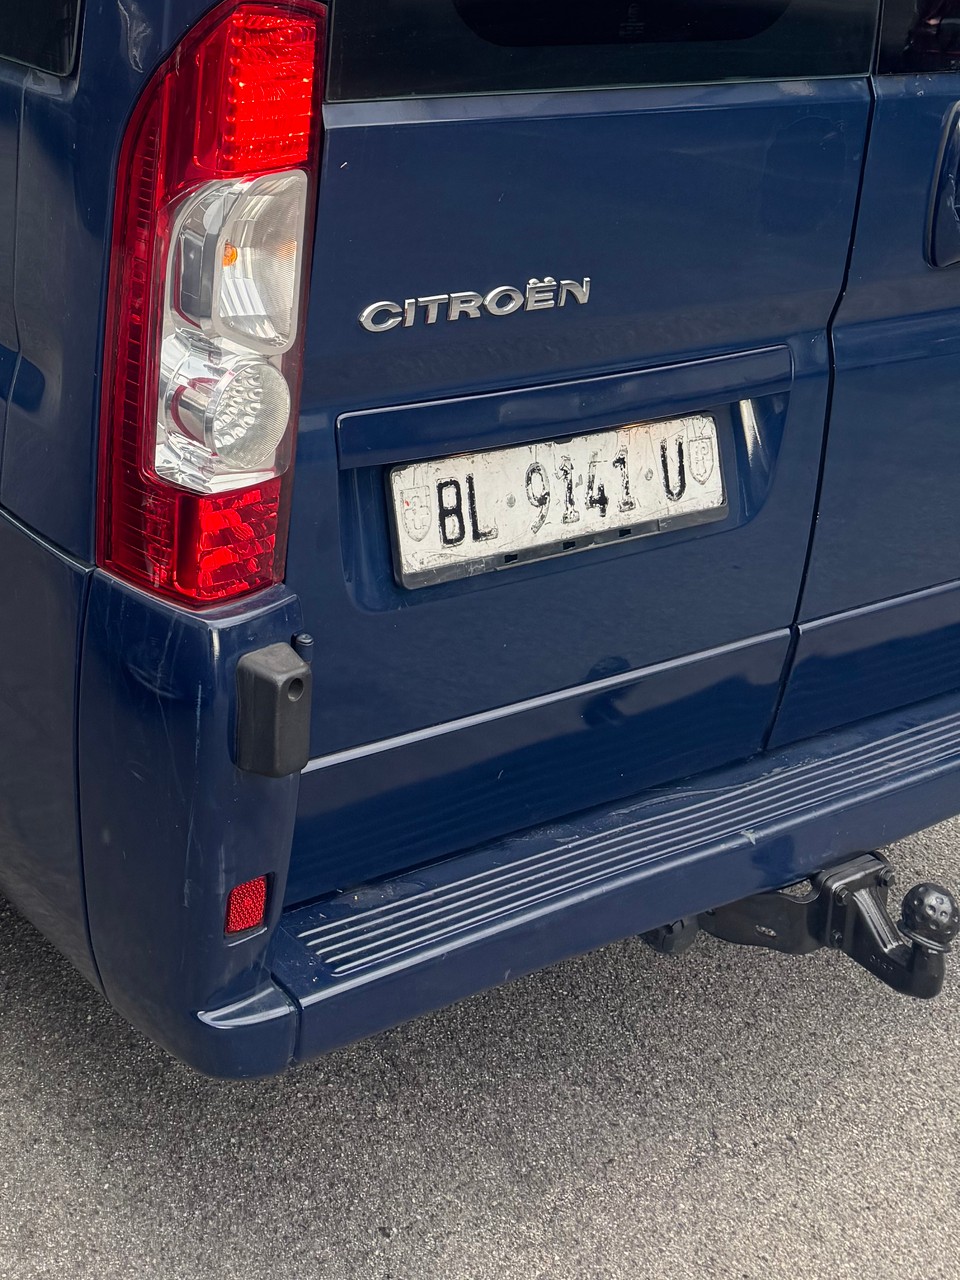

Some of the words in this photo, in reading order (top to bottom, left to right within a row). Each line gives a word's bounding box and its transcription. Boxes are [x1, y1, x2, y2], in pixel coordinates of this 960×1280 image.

[358, 277, 591, 332] CITROËN
[436, 472, 498, 546] BL
[524, 446, 637, 534] 9141
[659, 434, 688, 502] U
